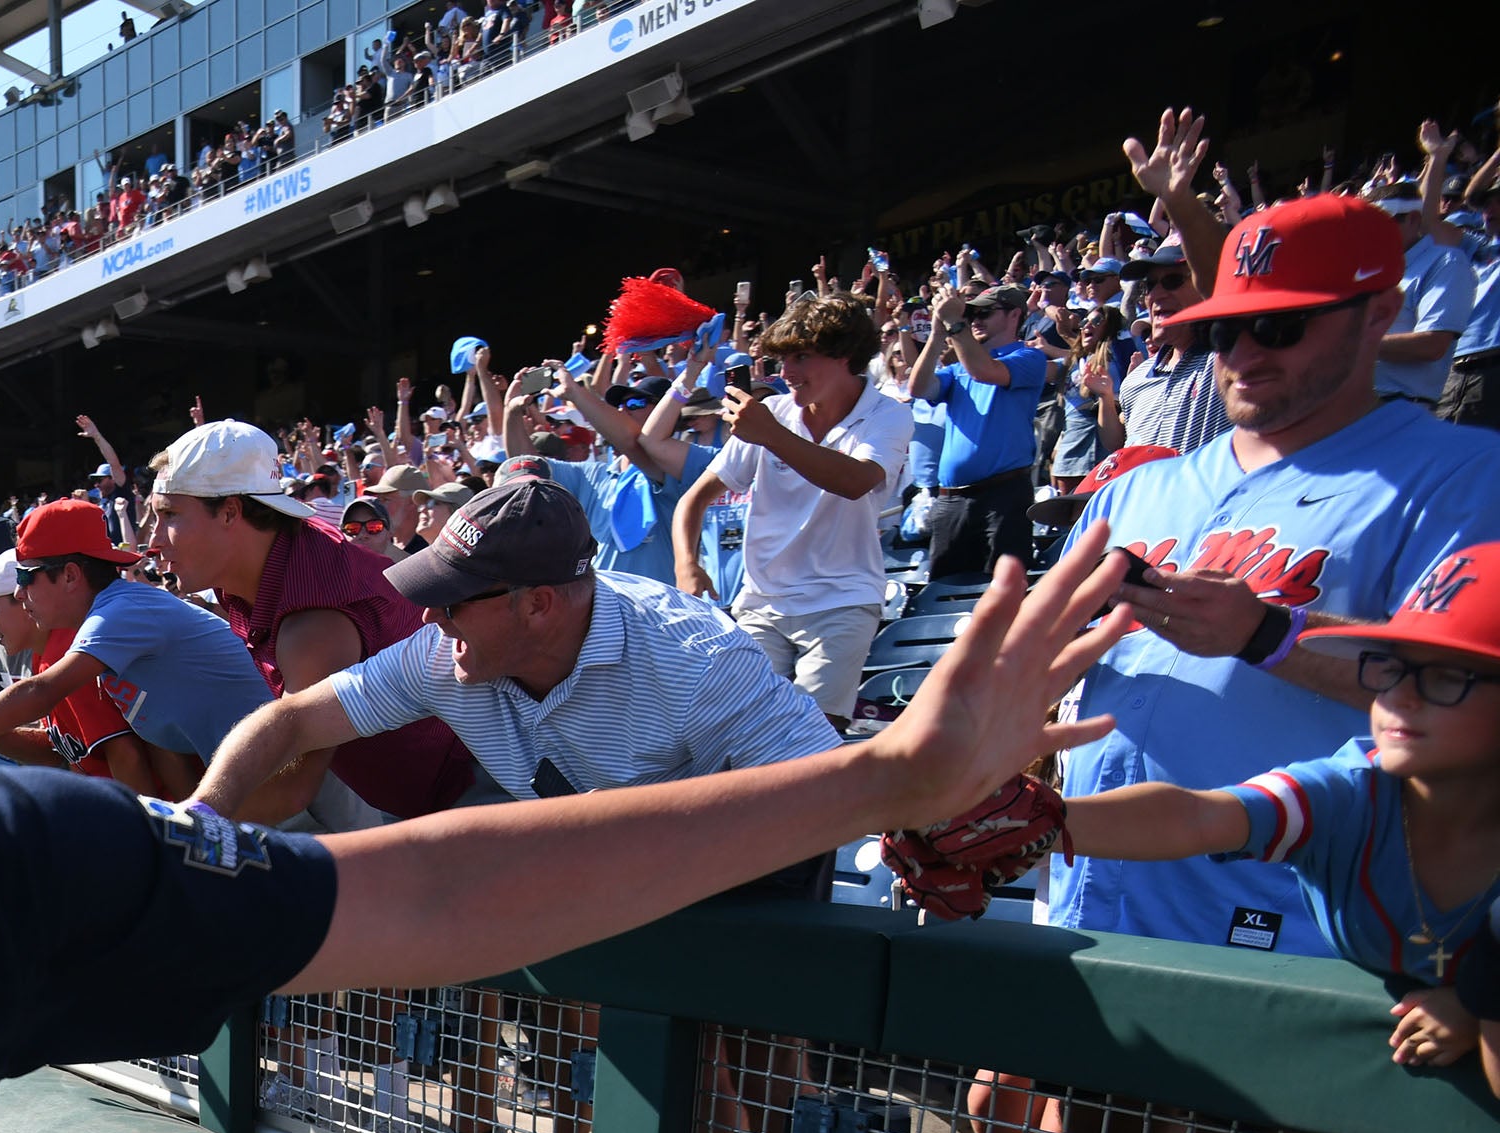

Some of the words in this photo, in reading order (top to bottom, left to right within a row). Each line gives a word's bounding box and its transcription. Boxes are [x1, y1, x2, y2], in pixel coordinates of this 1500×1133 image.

[638, 0, 696, 38] MEN'S
[243, 166, 311, 214] #MCWS
[102, 237, 175, 278] NCAA.com
[1243, 912, 1268, 927] XL
